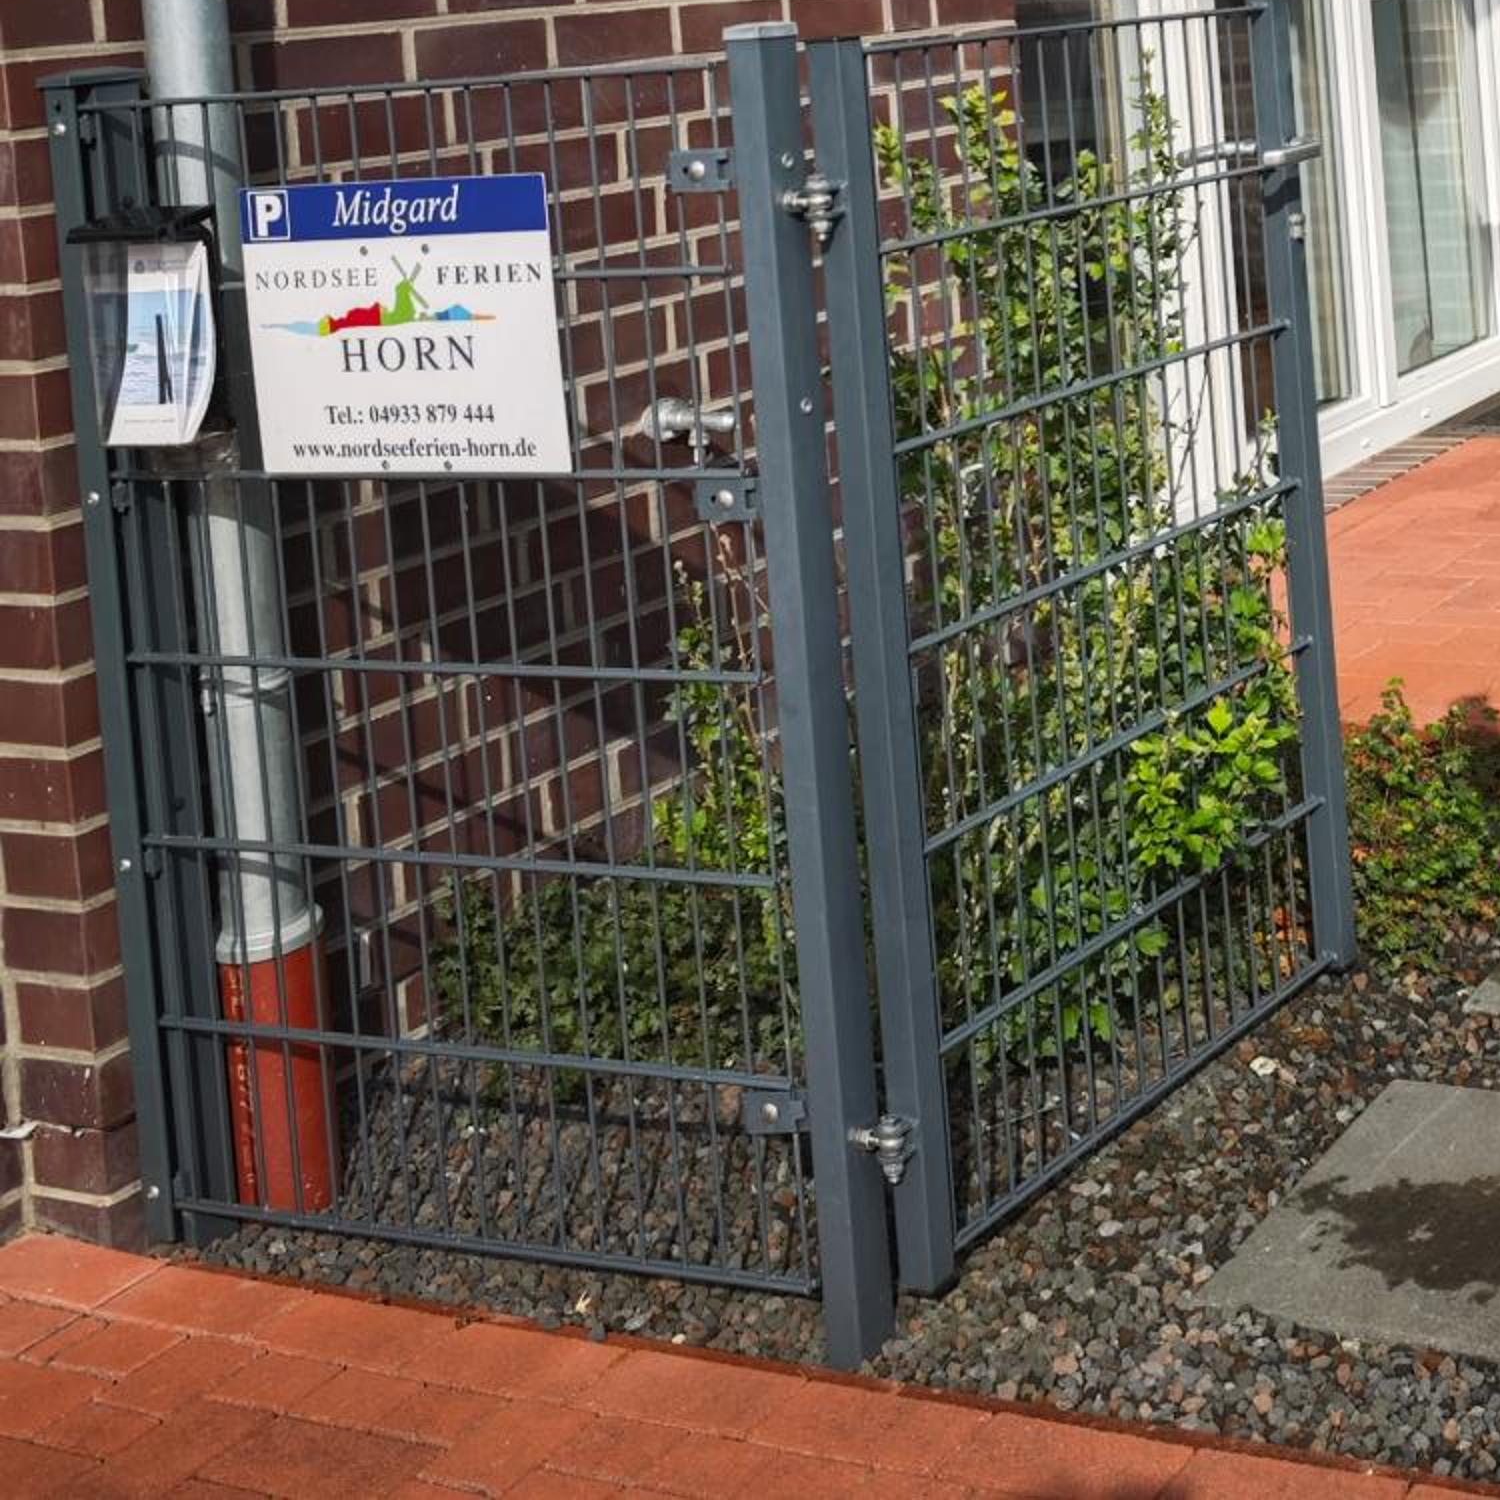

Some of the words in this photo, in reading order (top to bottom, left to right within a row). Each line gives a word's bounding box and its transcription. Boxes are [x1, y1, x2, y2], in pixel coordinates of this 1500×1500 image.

[256, 195, 283, 237] P
[333, 185, 458, 233] Midgard
[255, 267, 378, 290] NORDSEE
[437, 263, 542, 285] FERIEN
[341, 336, 475, 372] HORN
[326, 407, 364, 425] Tel.:
[369, 405, 421, 424] 04933
[426, 404, 457, 423] 879
[463, 404, 495, 423] 444
[293, 438, 536, 458] www.nordseeferien-horn.de
